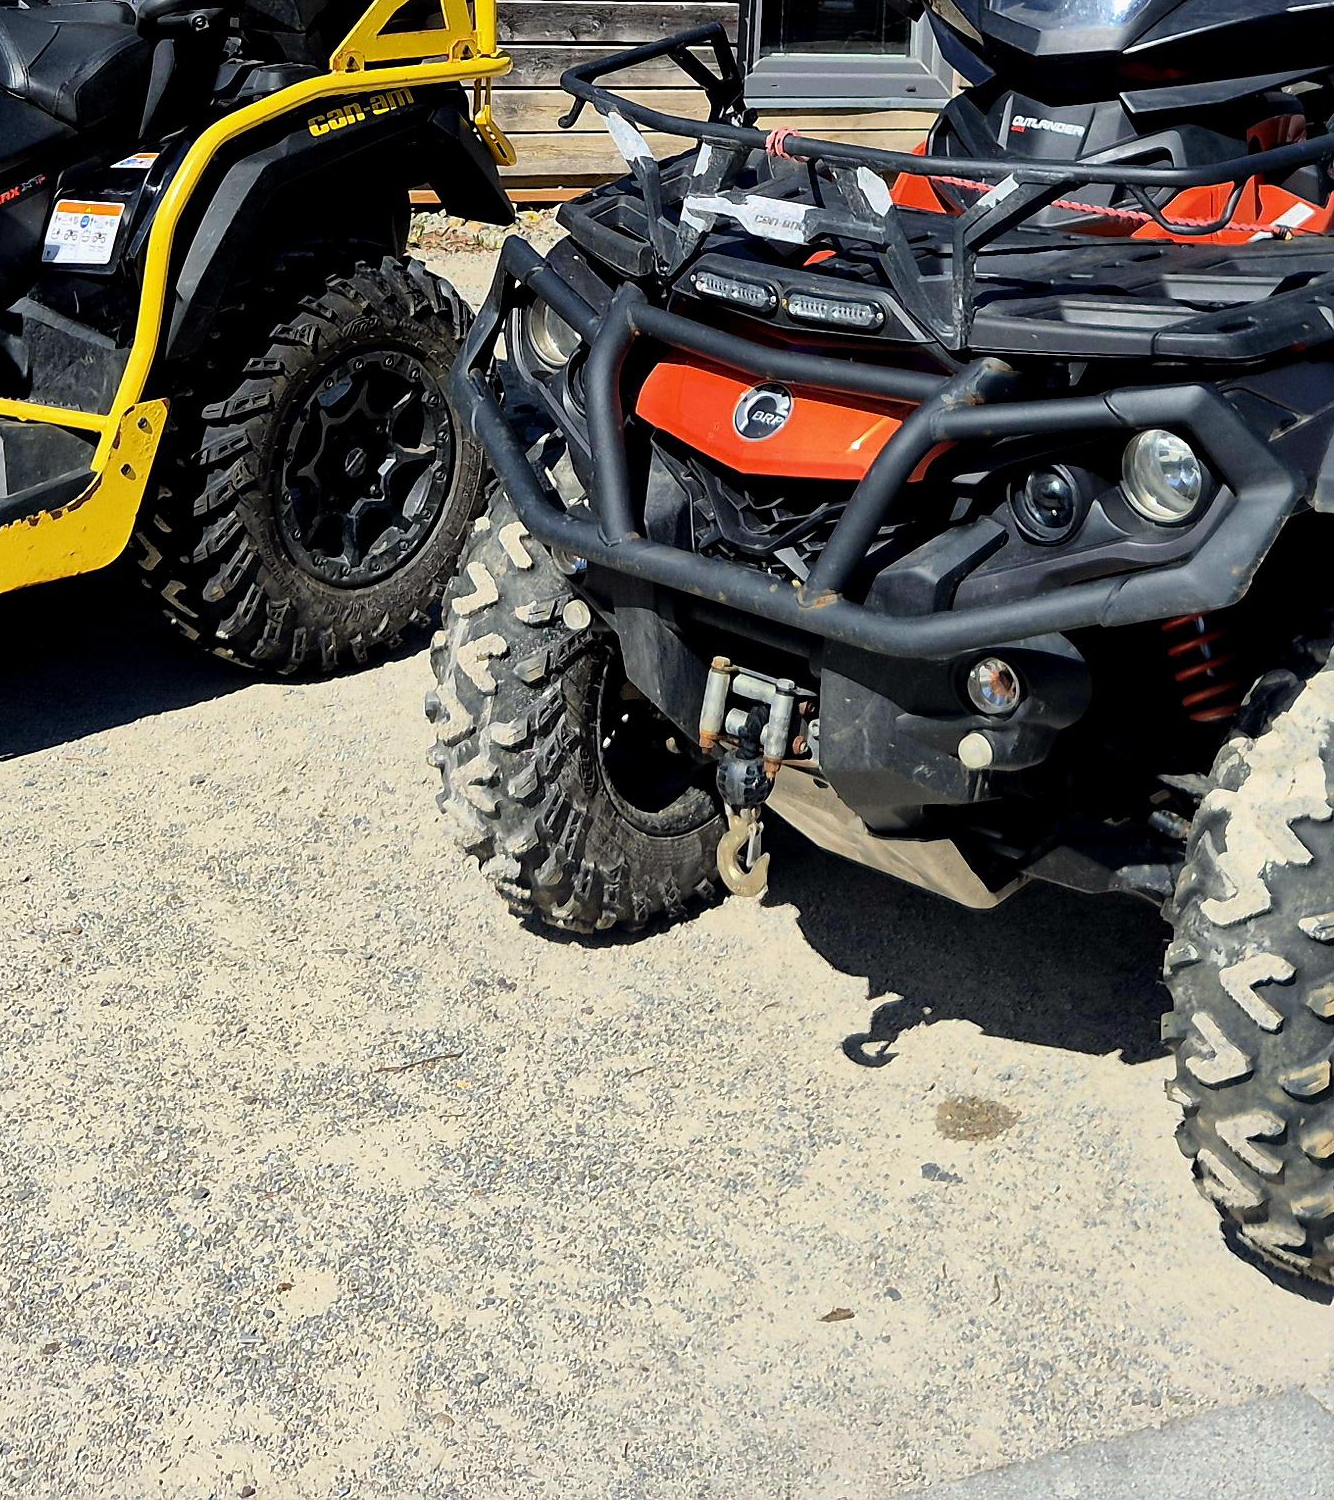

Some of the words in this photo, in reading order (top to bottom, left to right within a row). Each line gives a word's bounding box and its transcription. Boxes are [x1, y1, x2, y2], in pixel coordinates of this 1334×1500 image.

[307, 88, 415, 137] can-am
[1012, 115, 1085, 138] OUTLANDER
[751, 410, 786, 426] BRP
